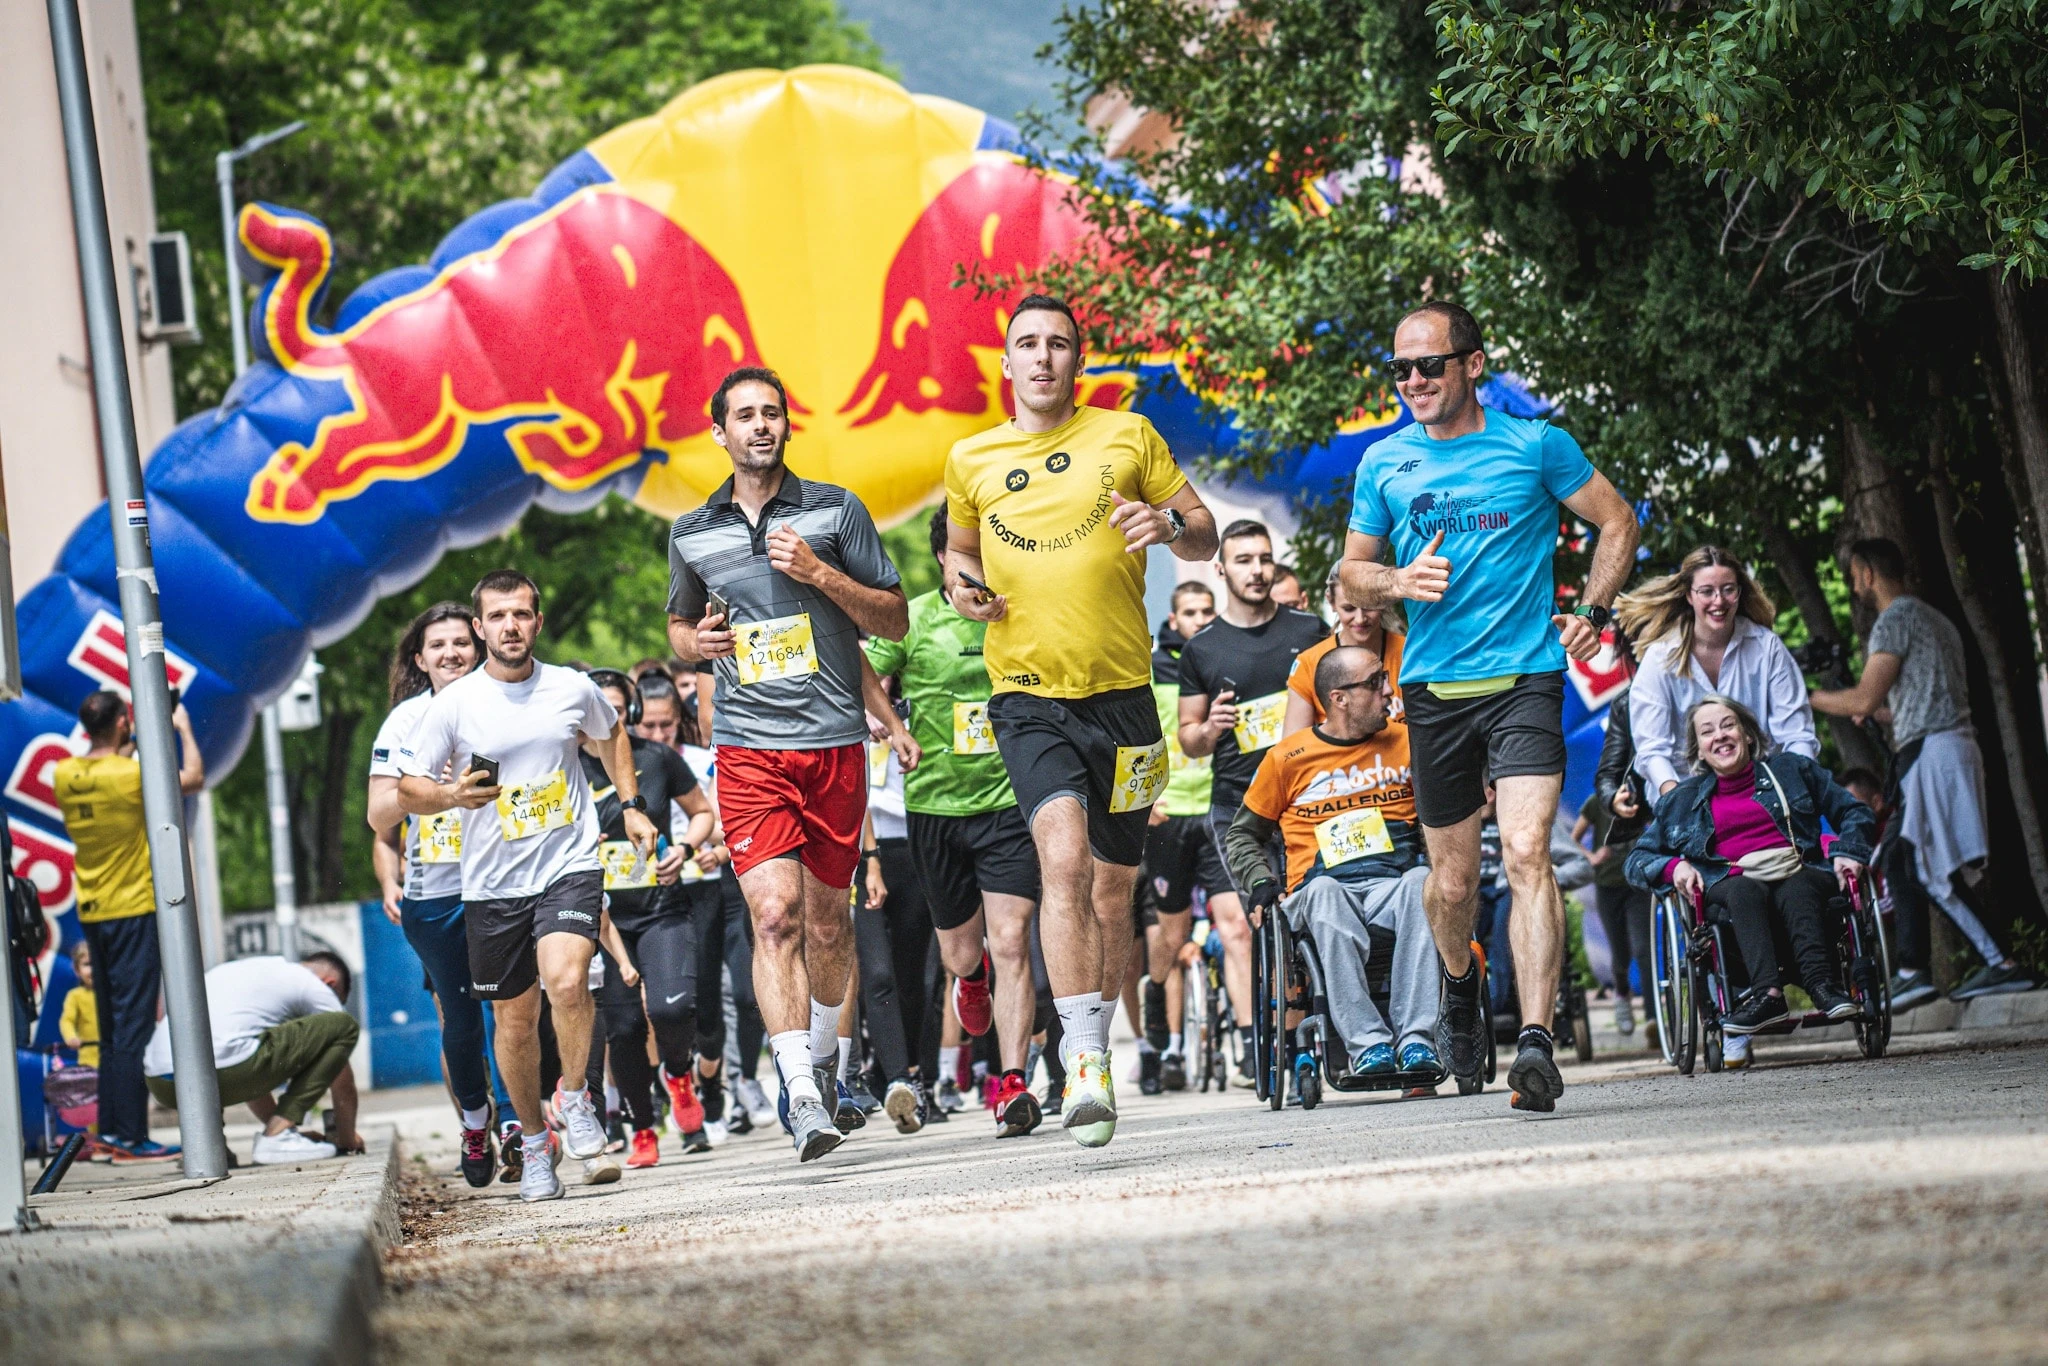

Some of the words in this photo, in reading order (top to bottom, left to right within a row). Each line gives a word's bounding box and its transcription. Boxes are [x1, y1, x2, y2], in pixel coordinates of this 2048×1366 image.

[1050, 456, 1066, 469] 22
[1009, 473, 1025, 488] 20
[988, 513, 1037, 552] MOSTAR
[1040, 532, 1074, 552] HALF
[1074, 464, 1115, 541] MARATHON
[749, 644, 804, 666] 121684
[1129, 770, 1163, 793] 97200
[511, 799, 562, 823] 144012
[1296, 786, 1410, 818] CHALLENGE
